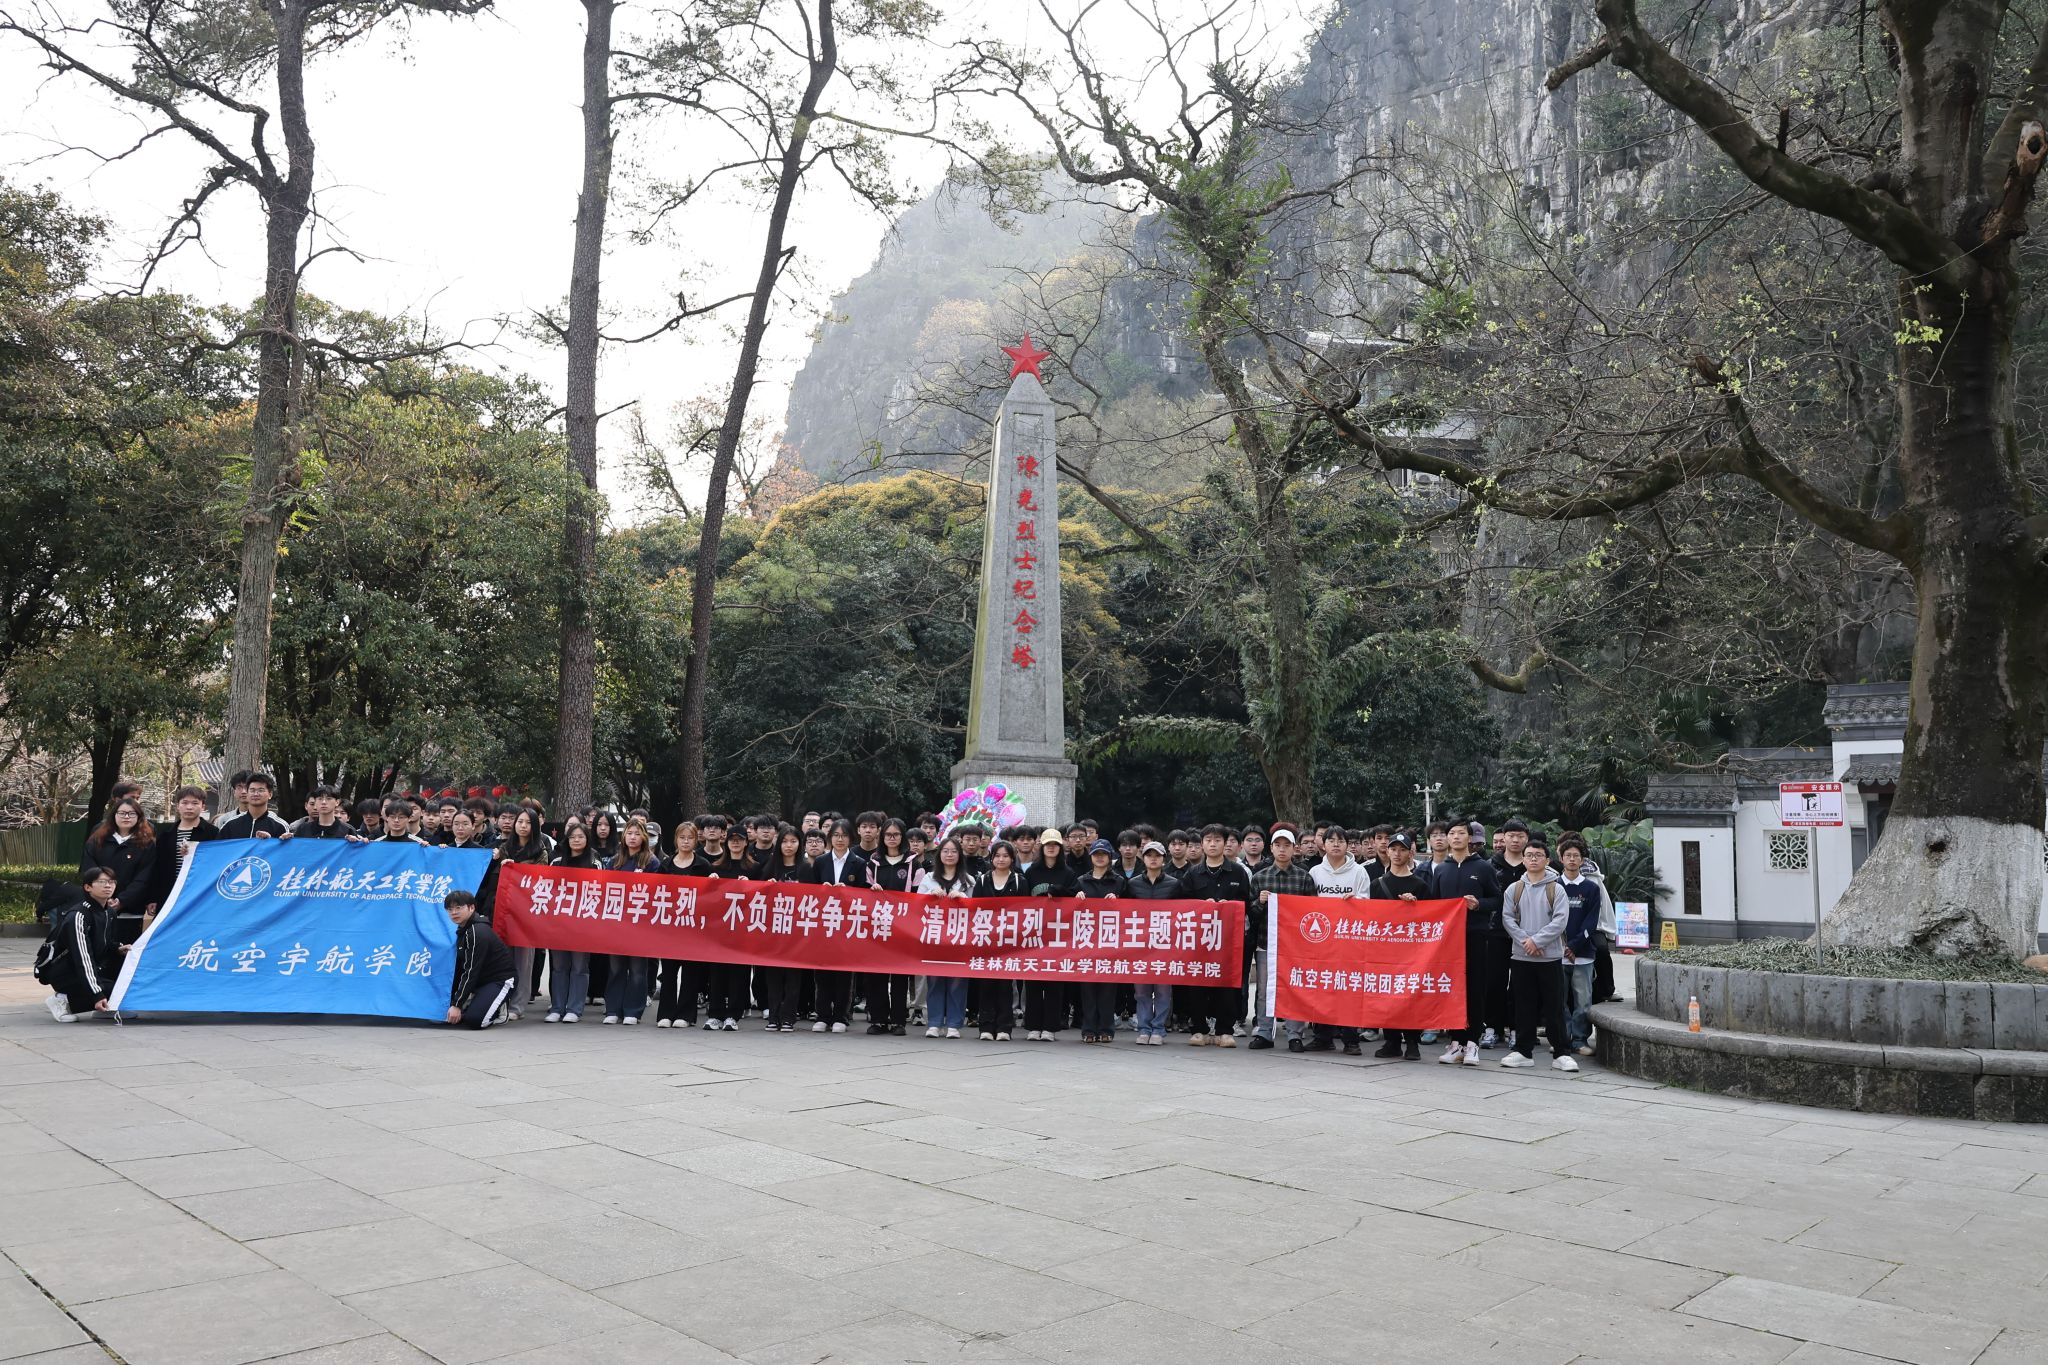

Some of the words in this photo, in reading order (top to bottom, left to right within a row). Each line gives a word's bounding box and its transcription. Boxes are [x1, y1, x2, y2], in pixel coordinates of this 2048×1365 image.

[302, 890, 348, 898] UNIVERSITY
[361, 892, 403, 900] AEROSPACE
[405, 893, 446, 904] TECHNOLOG
[177, 939, 432, 977] 航空宇航学院
[1289, 966, 1452, 994] 航空宇航学院团委学生会
